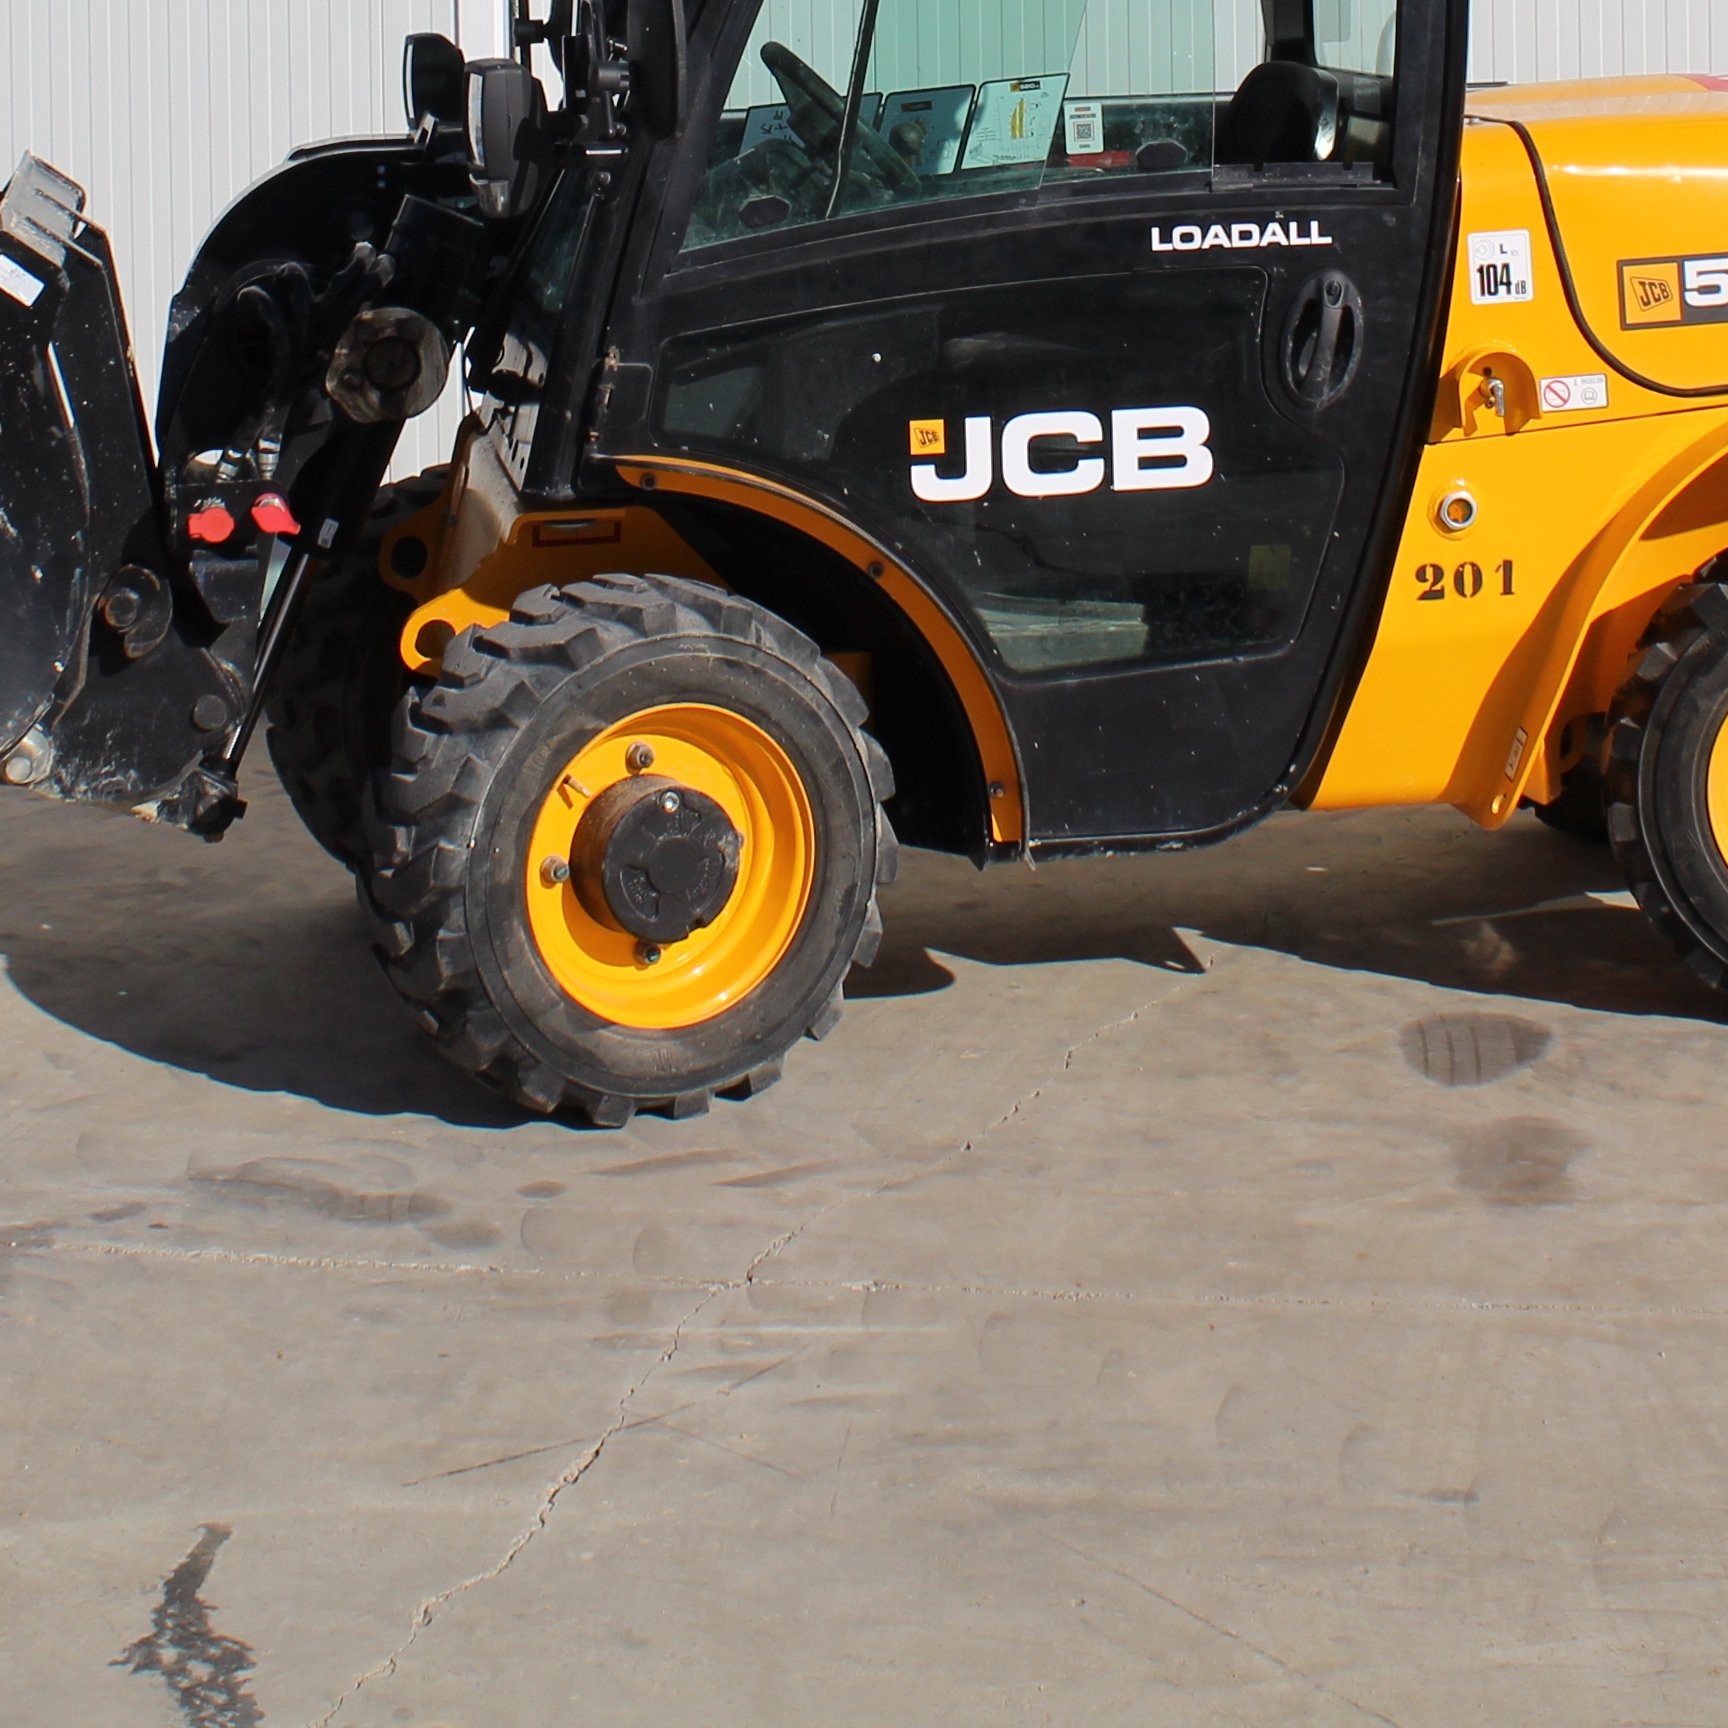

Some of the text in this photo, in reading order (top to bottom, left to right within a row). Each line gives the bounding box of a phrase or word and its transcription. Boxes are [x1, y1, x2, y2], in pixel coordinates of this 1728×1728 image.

[1151, 220, 1333, 252] LOADALL
[1476, 262, 1527, 297] 104 dB
[1638, 279, 1671, 309] JCB
[909, 404, 1214, 503] JCB
[916, 428, 941, 449] JCB
[1415, 559, 1516, 601] 201
